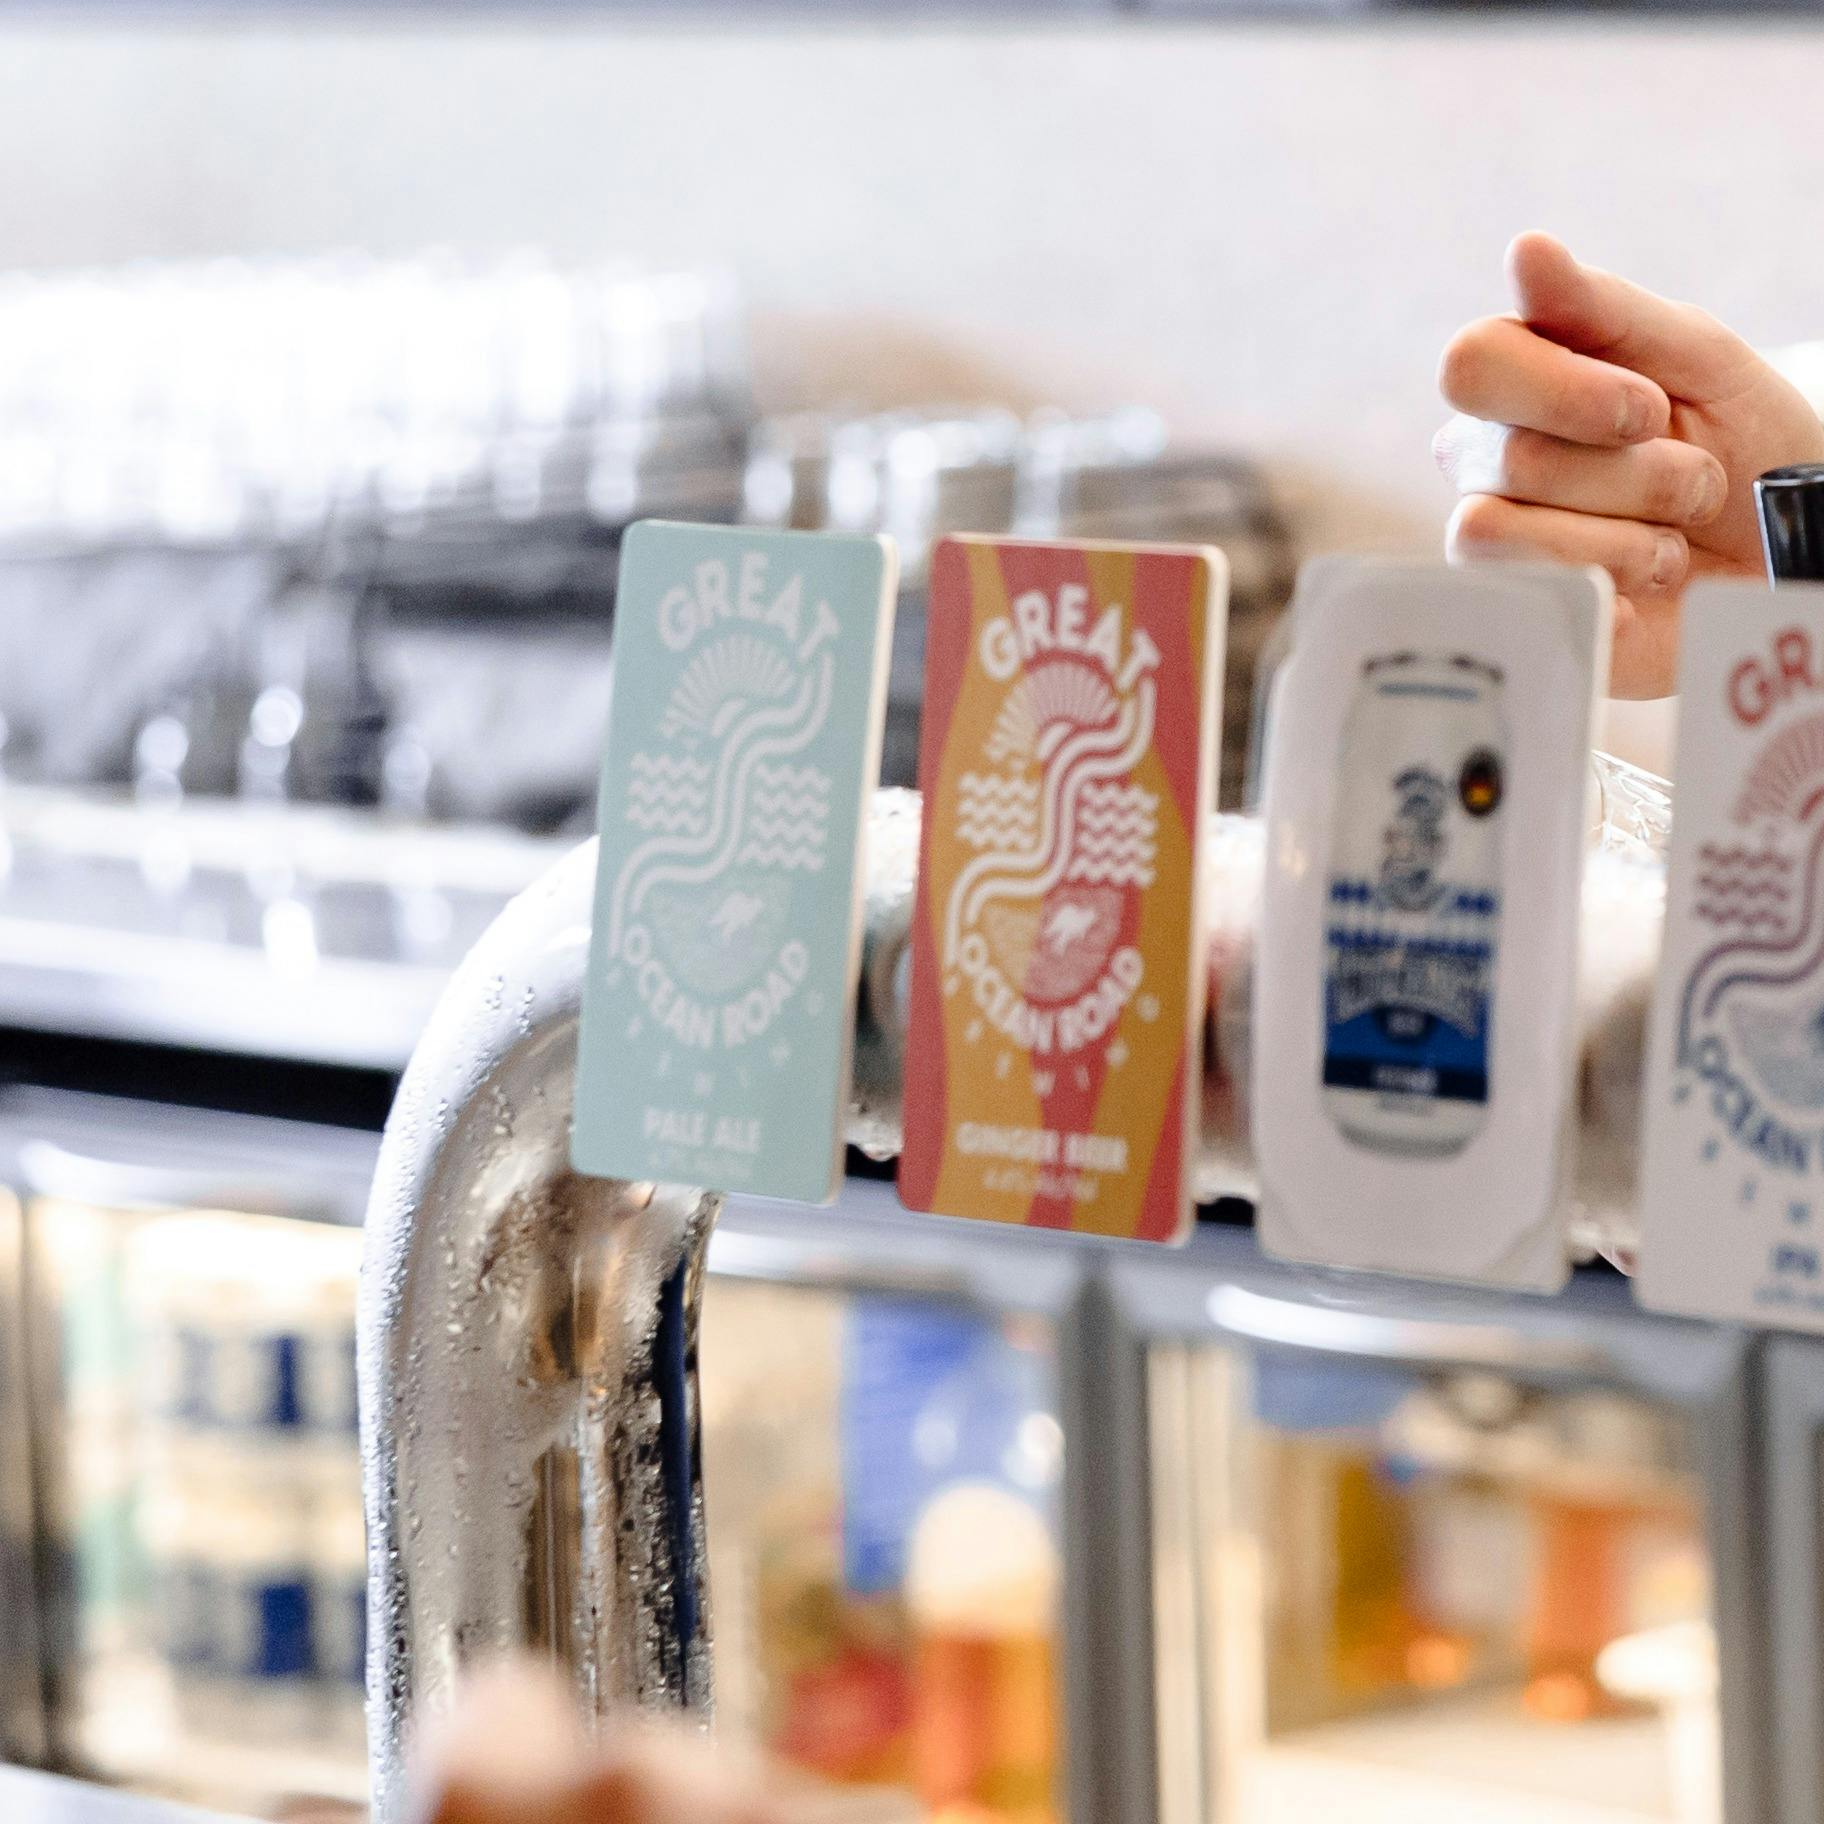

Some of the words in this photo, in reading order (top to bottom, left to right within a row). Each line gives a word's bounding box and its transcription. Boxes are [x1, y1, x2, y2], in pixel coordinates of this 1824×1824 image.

[657, 552, 840, 657] GREAT
[980, 583, 1160, 689] GREAT
[624, 927, 713, 1049] OCEAN
[724, 941, 808, 1048] ROAD
[959, 935, 1052, 1053] OCEAN
[1061, 946, 1143, 1053] ROAD
[645, 1105, 706, 1146] PALE
[712, 1115, 761, 1153] ALE
